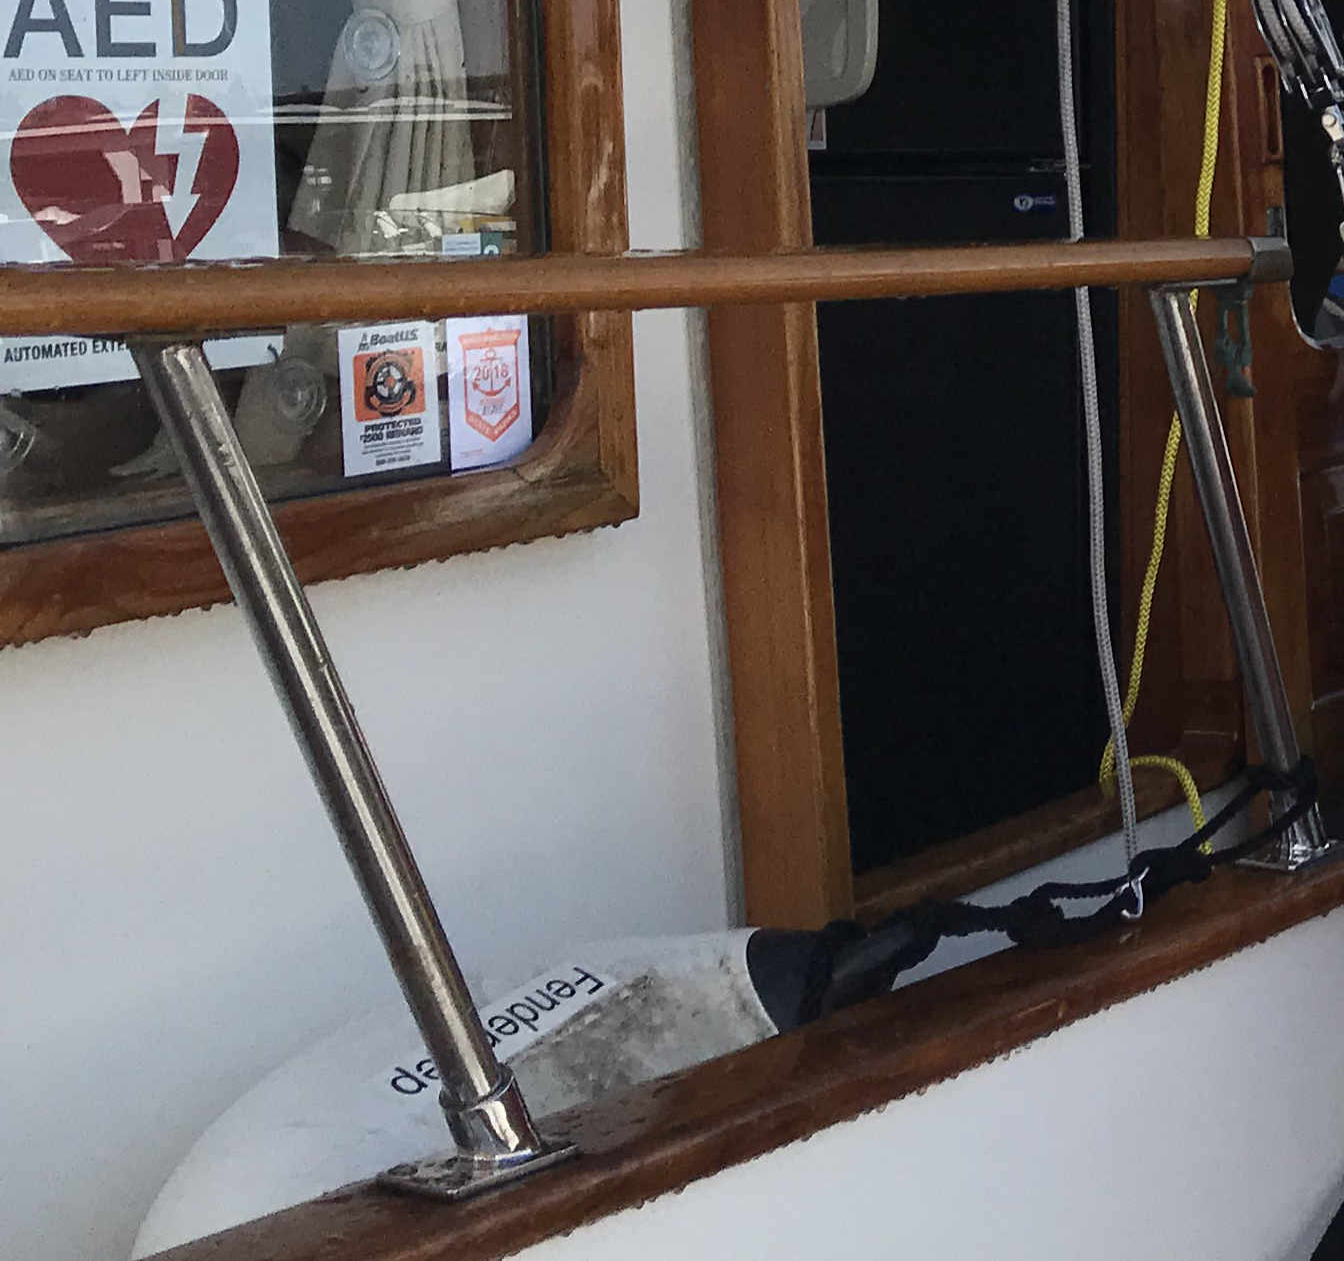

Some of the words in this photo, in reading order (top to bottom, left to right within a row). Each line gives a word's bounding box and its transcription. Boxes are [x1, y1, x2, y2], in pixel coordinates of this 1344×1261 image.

[8, 69, 35, 82] AED
[38, 69, 54, 82] ON
[59, 69, 93, 82] SEAT
[94, 69, 114, 82] TO
[117, 69, 148, 82] LEFT
[152, 68, 193, 82] INSIDE
[195, 68, 229, 82] DOOR
[4, 341, 88, 364] AUTOMATED
[473, 363, 509, 382] 2018
[486, 966, 605, 1048] Fender
